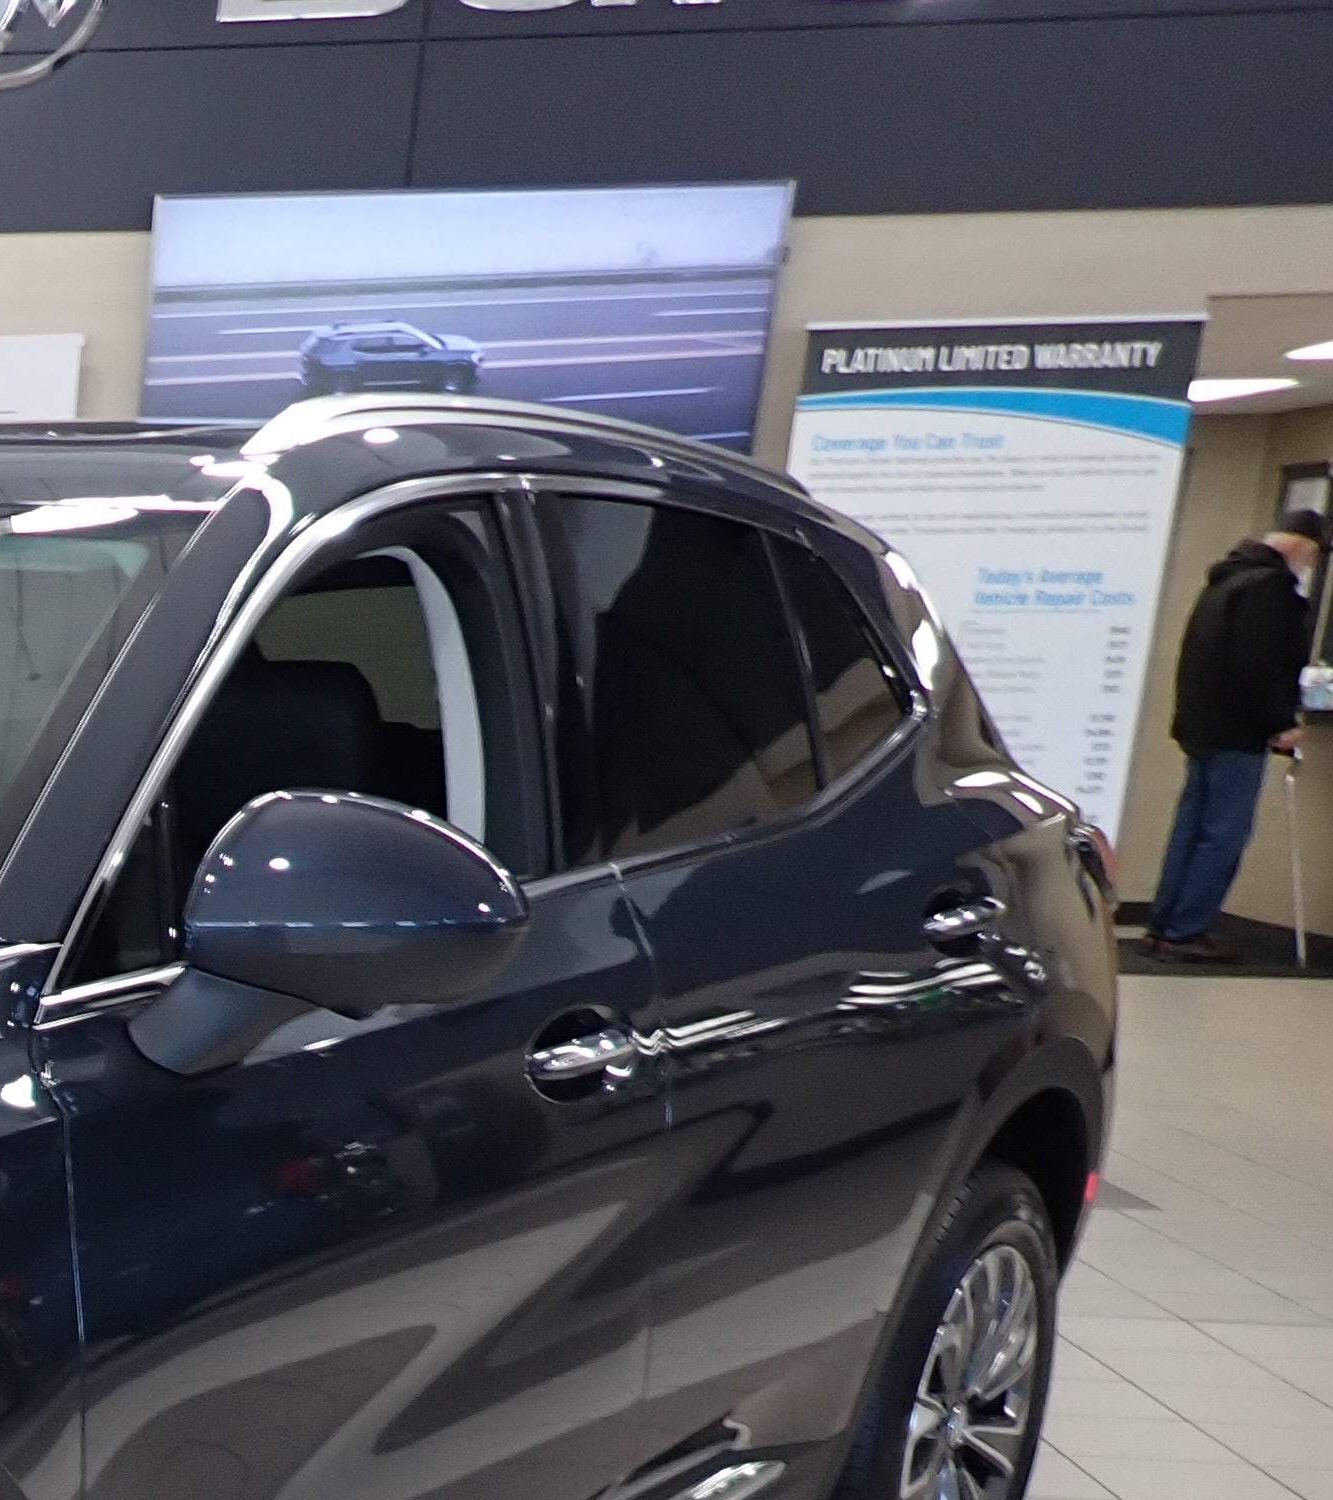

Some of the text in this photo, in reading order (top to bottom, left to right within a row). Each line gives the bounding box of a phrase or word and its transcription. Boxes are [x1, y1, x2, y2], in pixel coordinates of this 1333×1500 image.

[821, 341, 1164, 374] PLATINUM LIMITED WARRANTY
[811, 431, 1006, 453] Coverage You Can Trust
[1040, 568, 1104, 585] Average
[975, 590, 1136, 607] Vehicle Repair Costs
